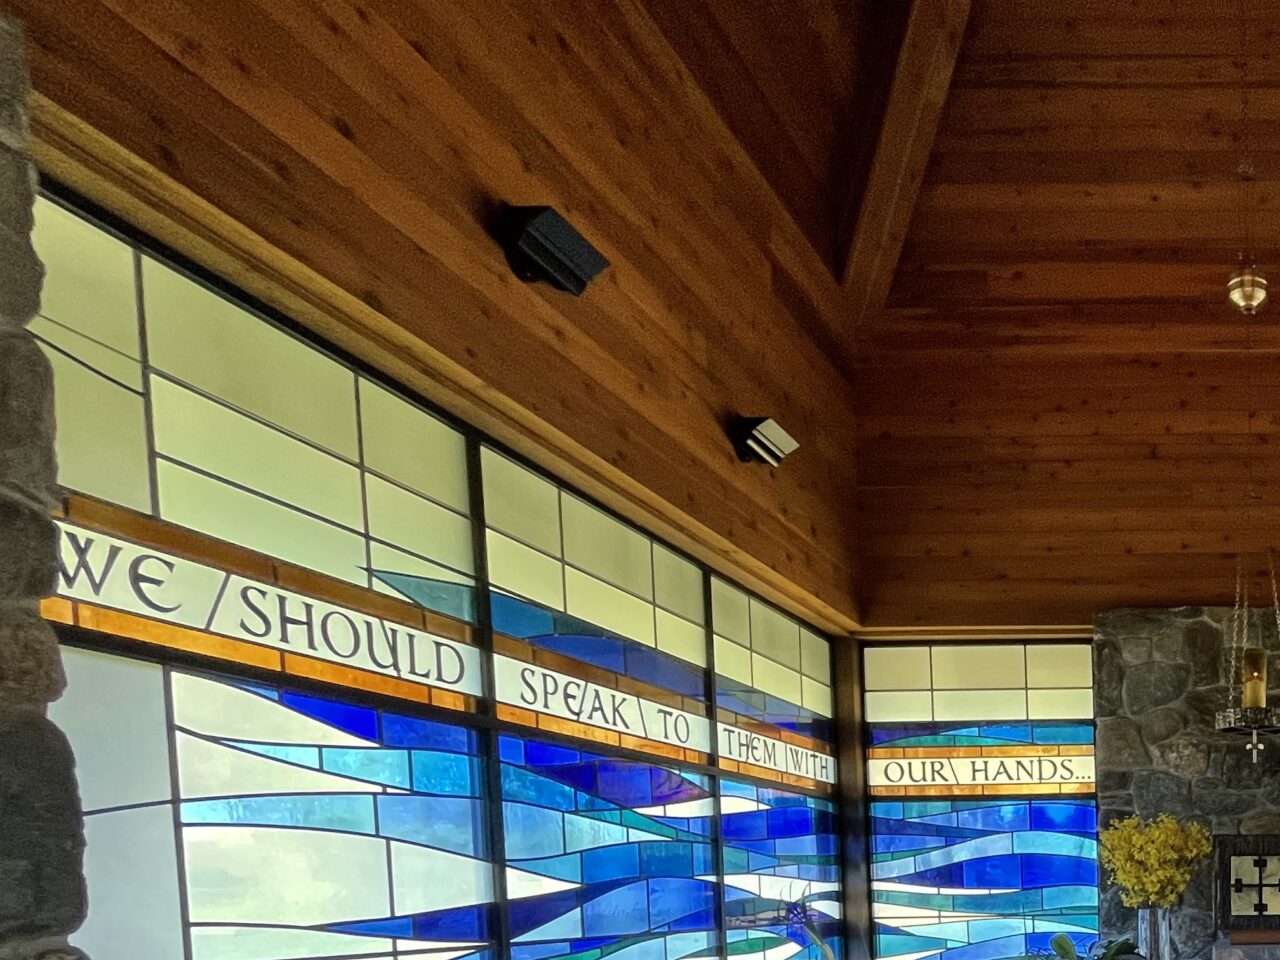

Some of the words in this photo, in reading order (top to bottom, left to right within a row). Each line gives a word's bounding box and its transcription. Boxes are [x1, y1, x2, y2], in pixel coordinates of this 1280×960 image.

[58, 531, 182, 613] WE
[239, 585, 466, 686] SHOULD
[520, 667, 630, 730] SPEAK
[657, 708, 690, 745] TO
[723, 727, 777, 767] THEM
[789, 746, 829, 780] WITH
[883, 760, 949, 783] OUR
[971, 758, 1092, 782] HANDS...
